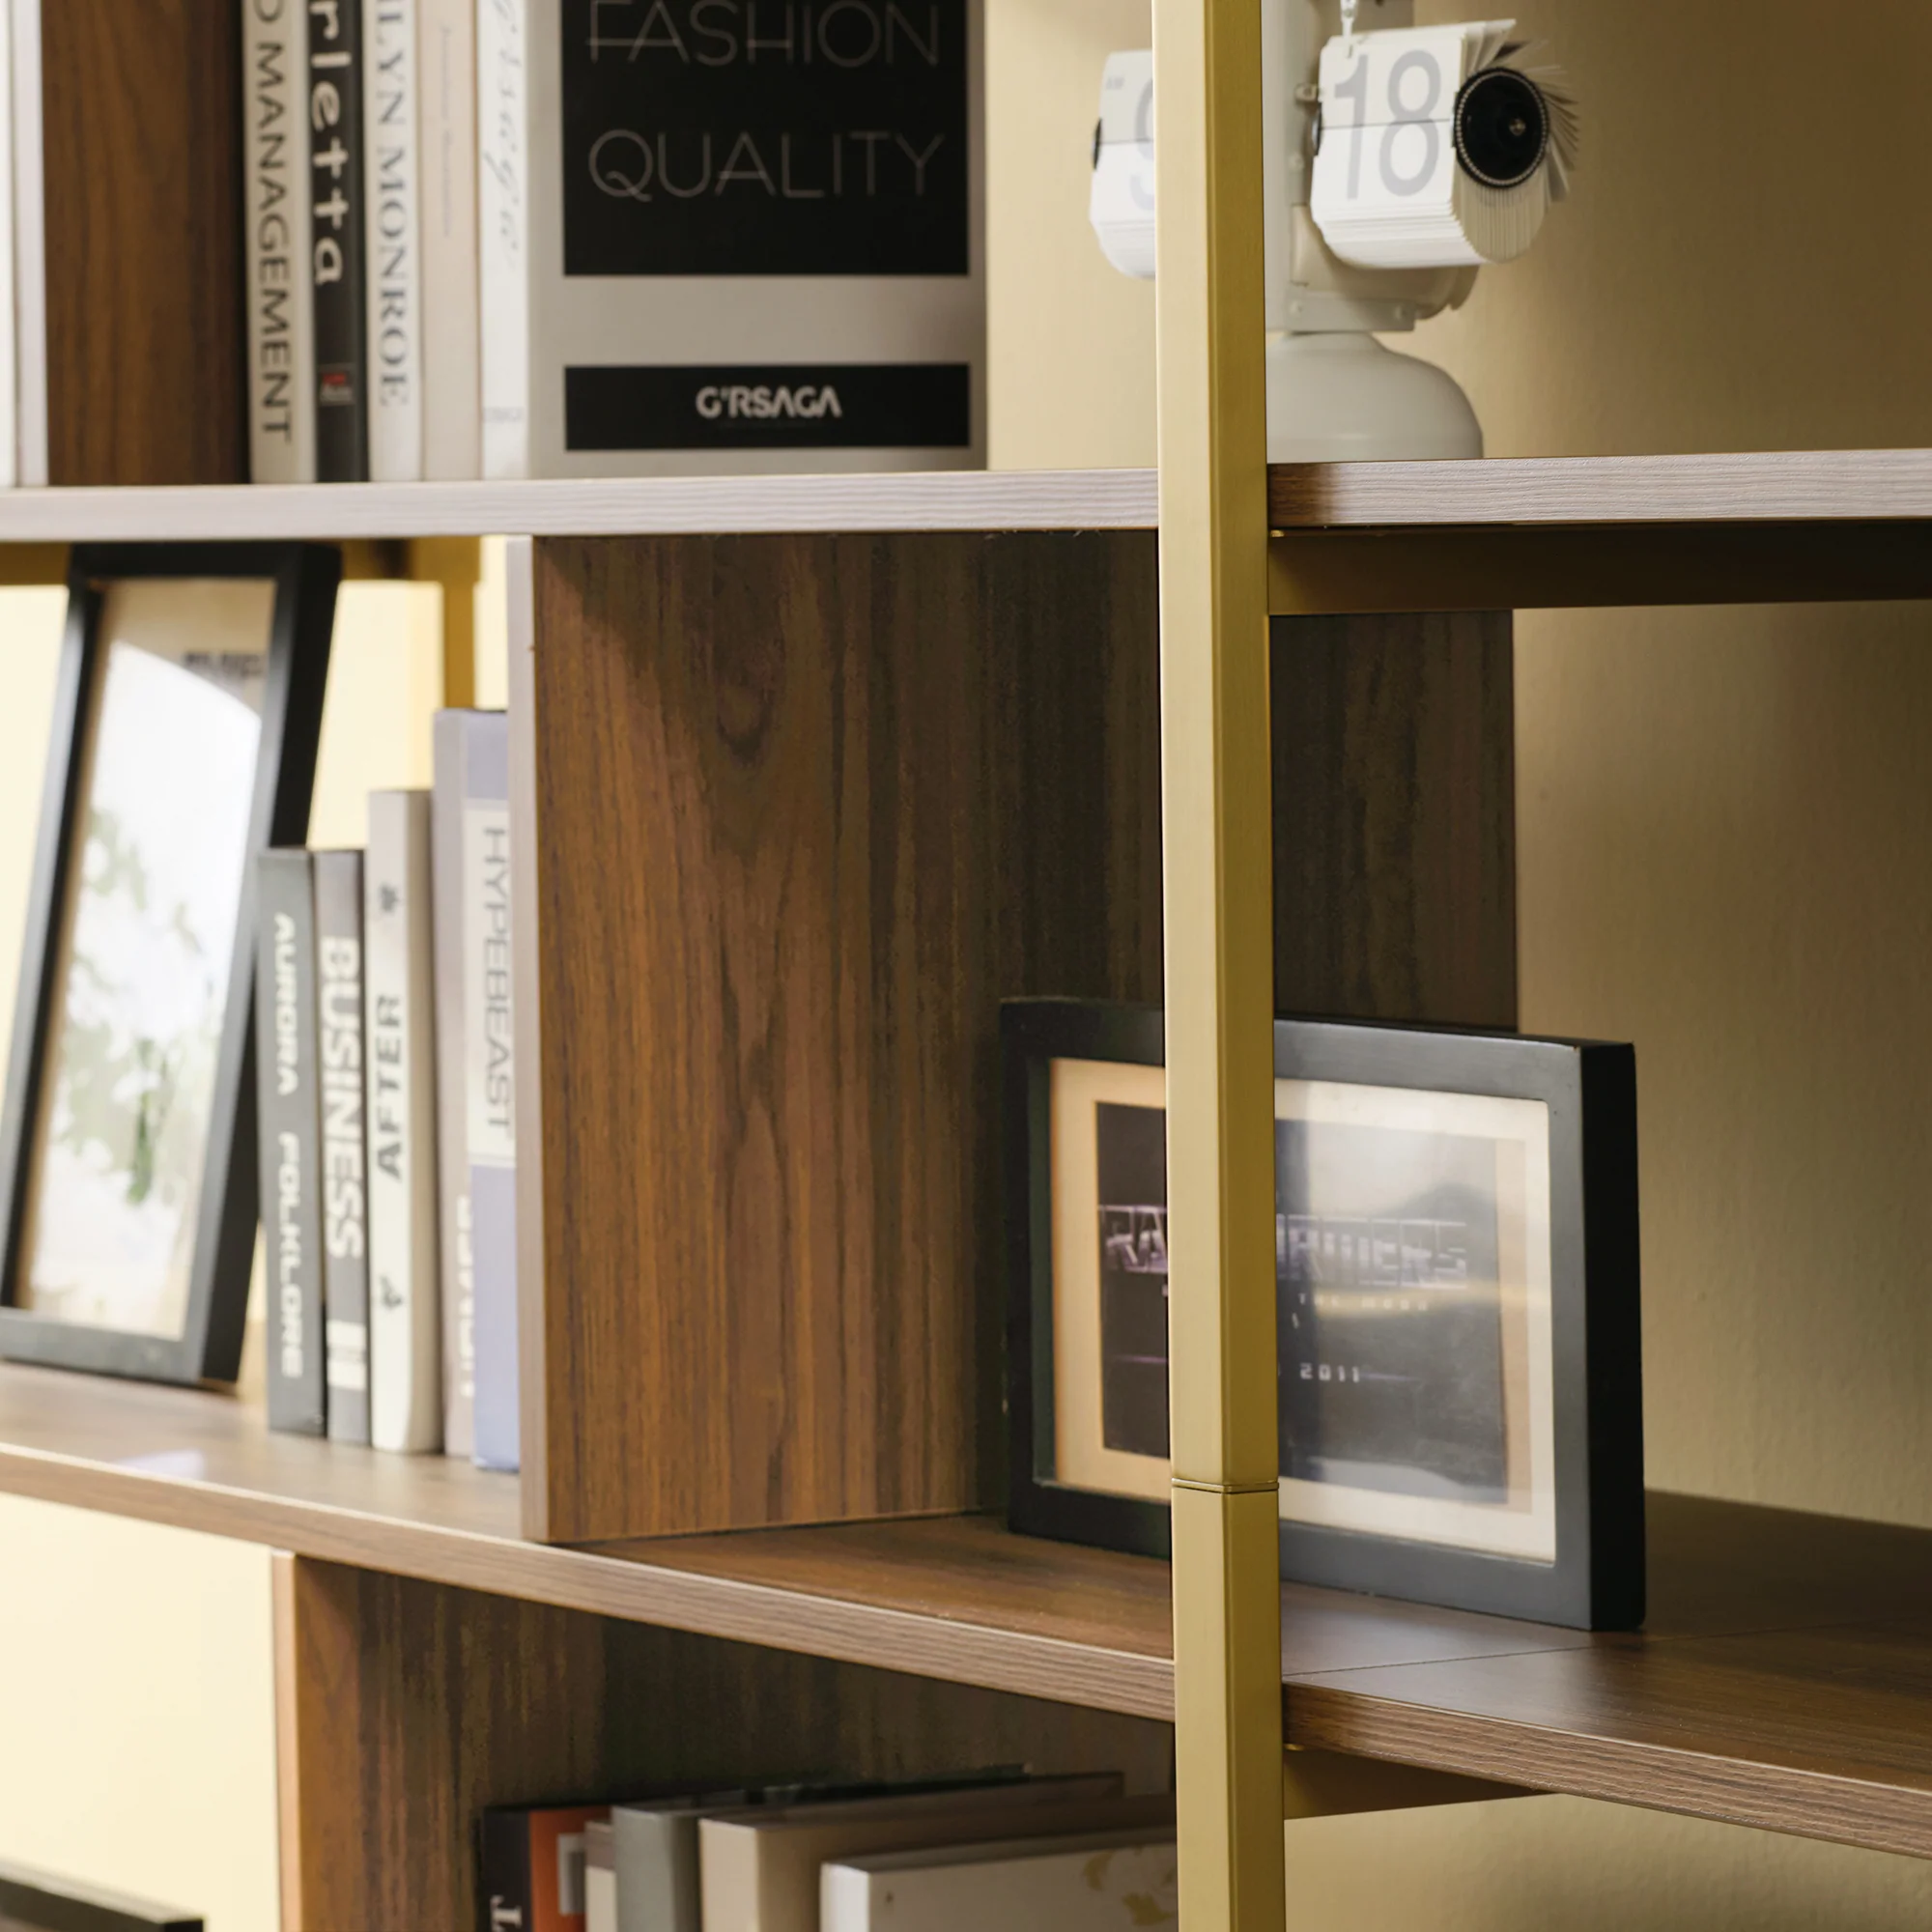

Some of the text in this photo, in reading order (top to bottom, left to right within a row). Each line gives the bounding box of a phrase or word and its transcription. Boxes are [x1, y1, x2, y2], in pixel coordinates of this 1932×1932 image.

[585, 0, 941, 67] FASHION
[1334, 49, 1441, 200] 18
[255, 42, 292, 442] MANAGEMENT
[377, 0, 410, 407] LYN MONROE
[587, 128, 945, 202] QUALITY
[319, 935, 365, 1259] BUSINESS
[375, 992, 402, 1182] AFTER
[483, 826, 514, 1138] HYPEBEAST
[274, 911, 303, 1378] AURORA FOLKLORE
[1299, 1362, 1361, 1383] 2011
